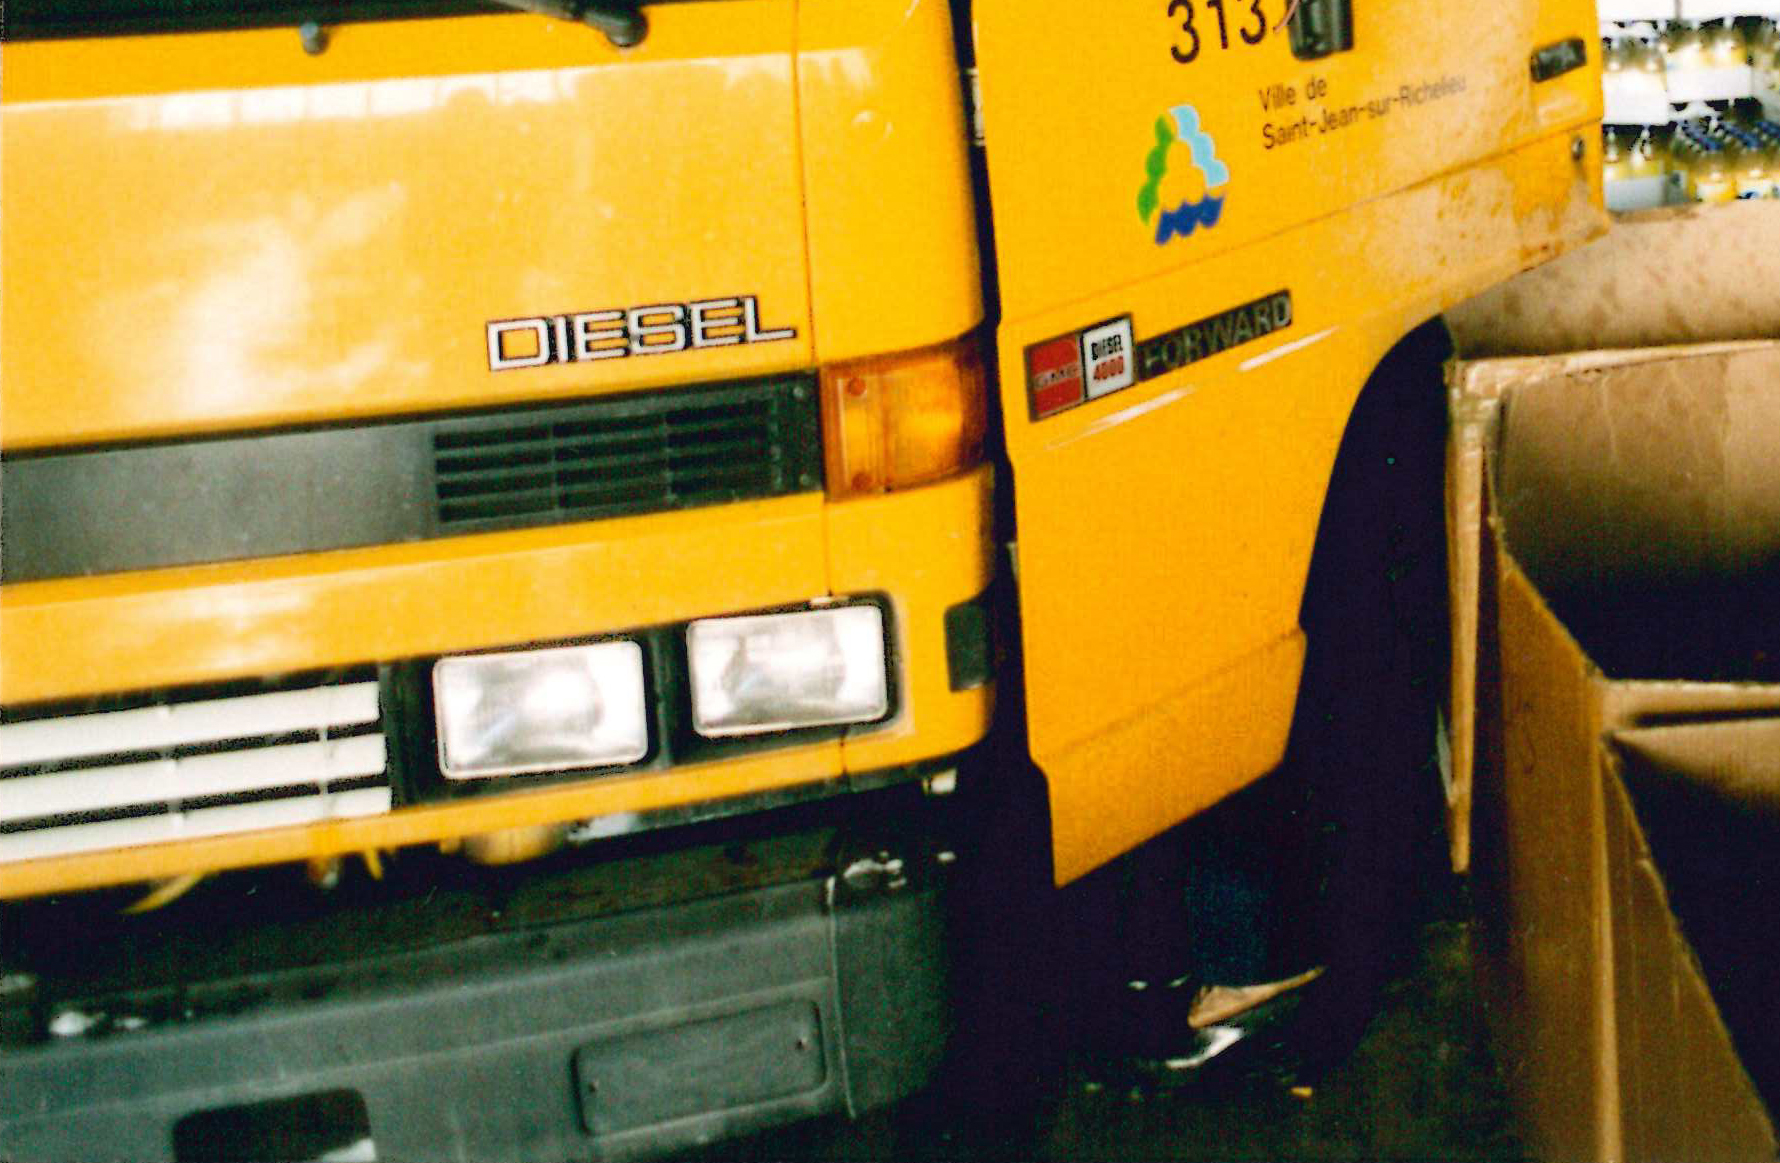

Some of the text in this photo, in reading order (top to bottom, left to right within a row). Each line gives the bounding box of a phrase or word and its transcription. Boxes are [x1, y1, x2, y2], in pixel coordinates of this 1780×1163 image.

[1258, 75, 1328, 112] Ville de
[1262, 74, 1467, 150] Saint-Jean-sur-Richelieu
[486, 294, 796, 372] DIESEL
[1143, 295, 1291, 377] FORWARD
